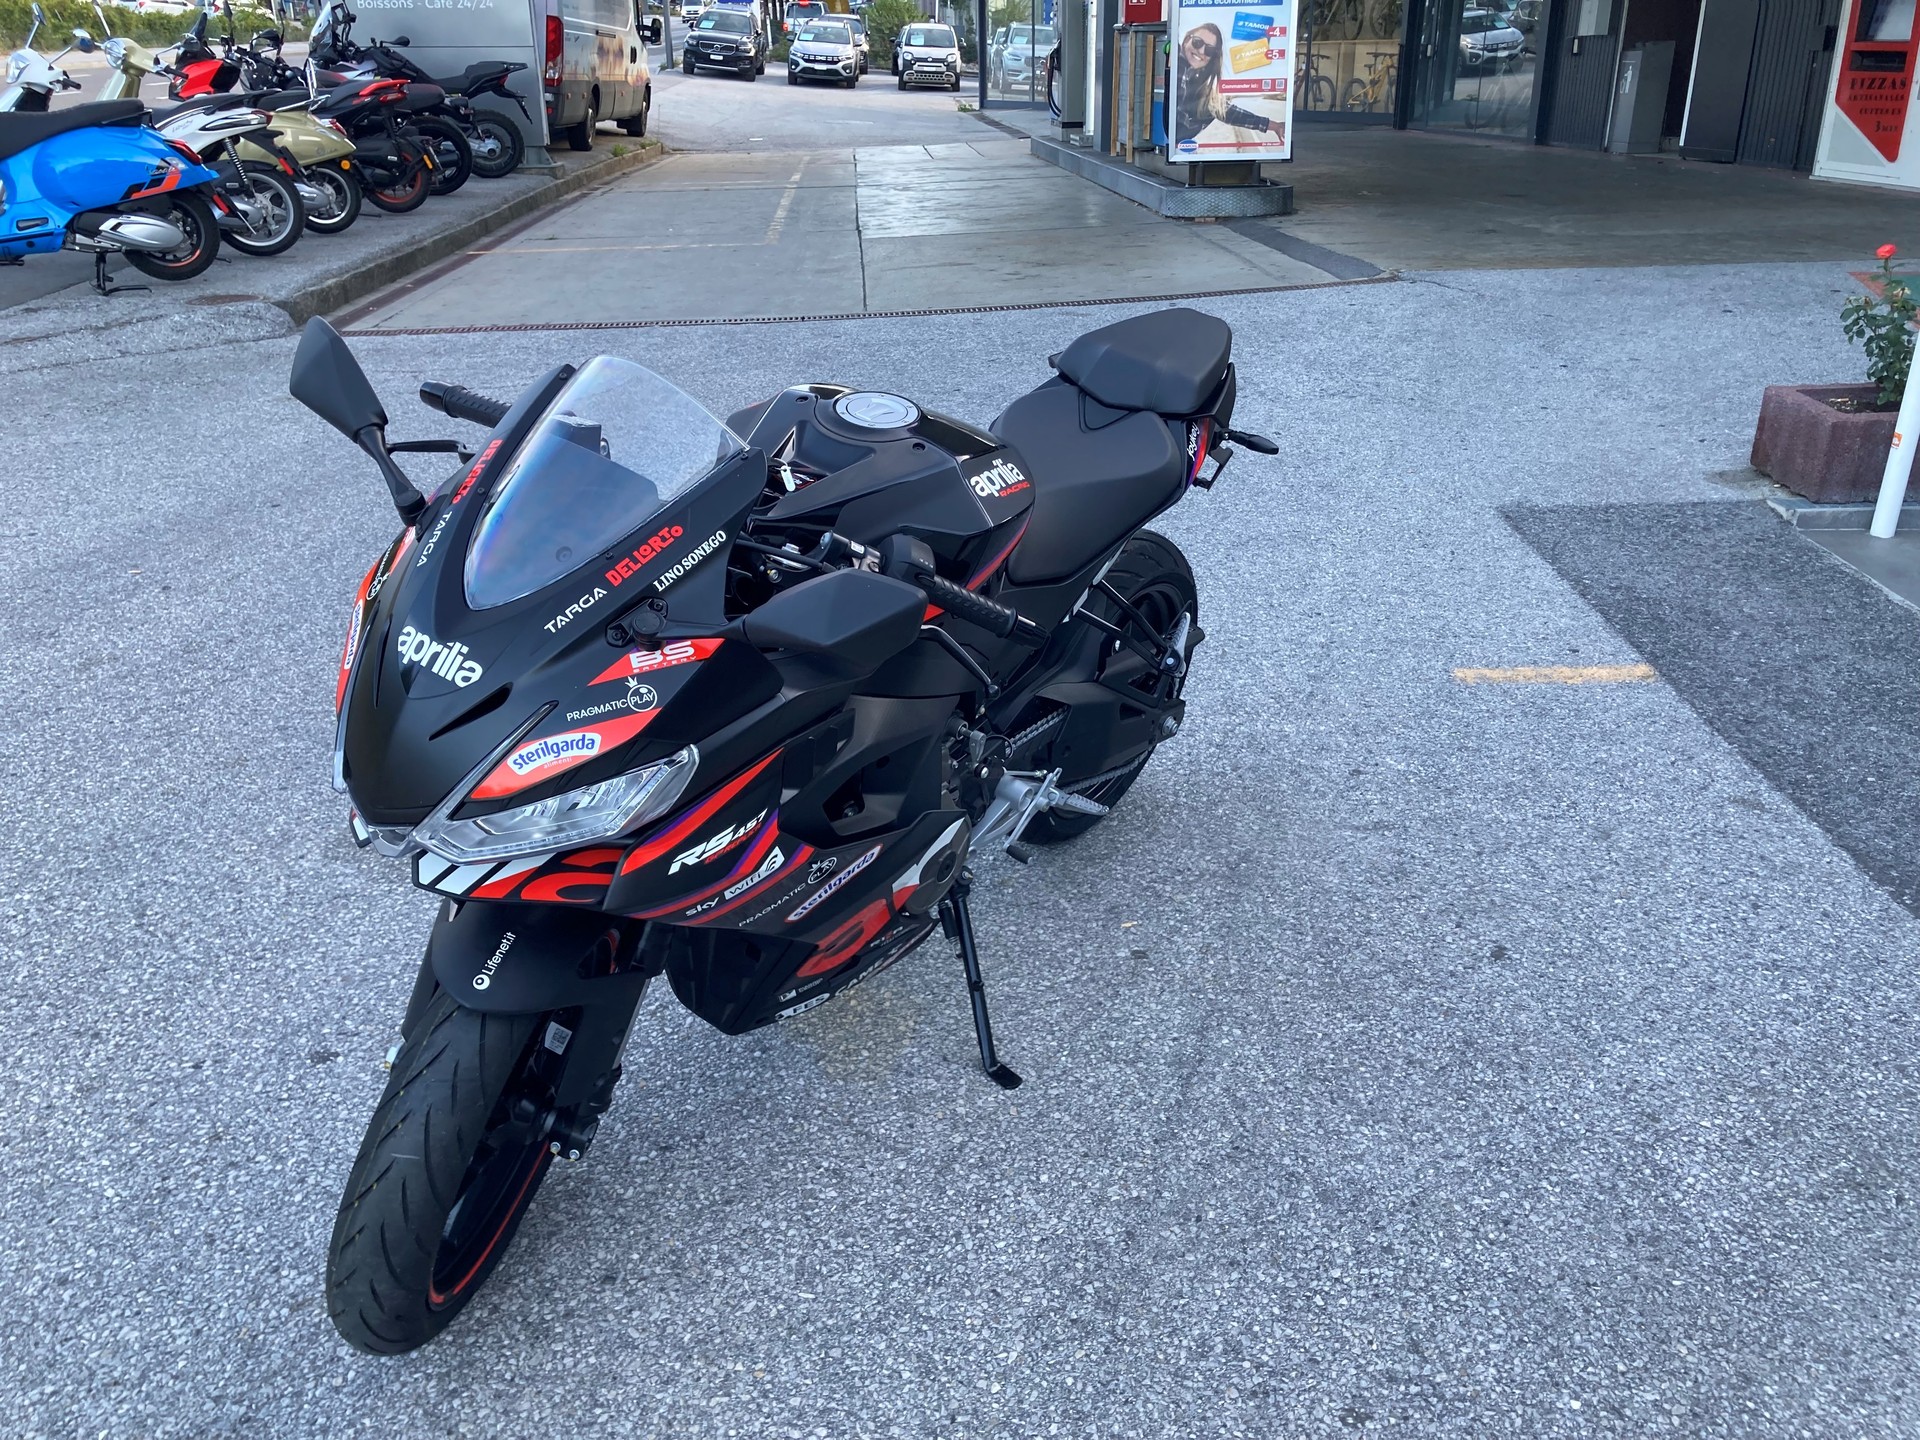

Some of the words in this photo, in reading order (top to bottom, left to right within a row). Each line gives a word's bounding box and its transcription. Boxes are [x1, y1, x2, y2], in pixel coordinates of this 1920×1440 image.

[357, 0, 414, 9] Boissons
[457, 0, 494, 11] 24/24
[1269, 27, 1280, 37] -4
[1850, 77, 1907, 90] PIZZAS
[970, 458, 1026, 498] aprilia
[999, 481, 1030, 498] RACING
[416, 511, 453, 568] TARGA
[652, 566, 684, 593] LINO
[684, 529, 727, 571] SONEGO
[543, 586, 607, 634] TARGA
[397, 624, 484, 689] aprilia
[629, 640, 695, 669] BS
[632, 655, 697, 673] BATTERY
[565, 697, 630, 723] PRAGMATIC
[630, 690, 656, 706] PLAY
[512, 734, 596, 771] sterilgarda
[667, 823, 737, 876] RS
[731, 807, 769, 841] 457
[738, 882, 807, 928] PRAGMATIC
[810, 859, 835, 882] PLAY
[793, 851, 876, 919] sterilgarda
[685, 896, 720, 917] sky
[481, 931, 517, 976] Lifenet.it
